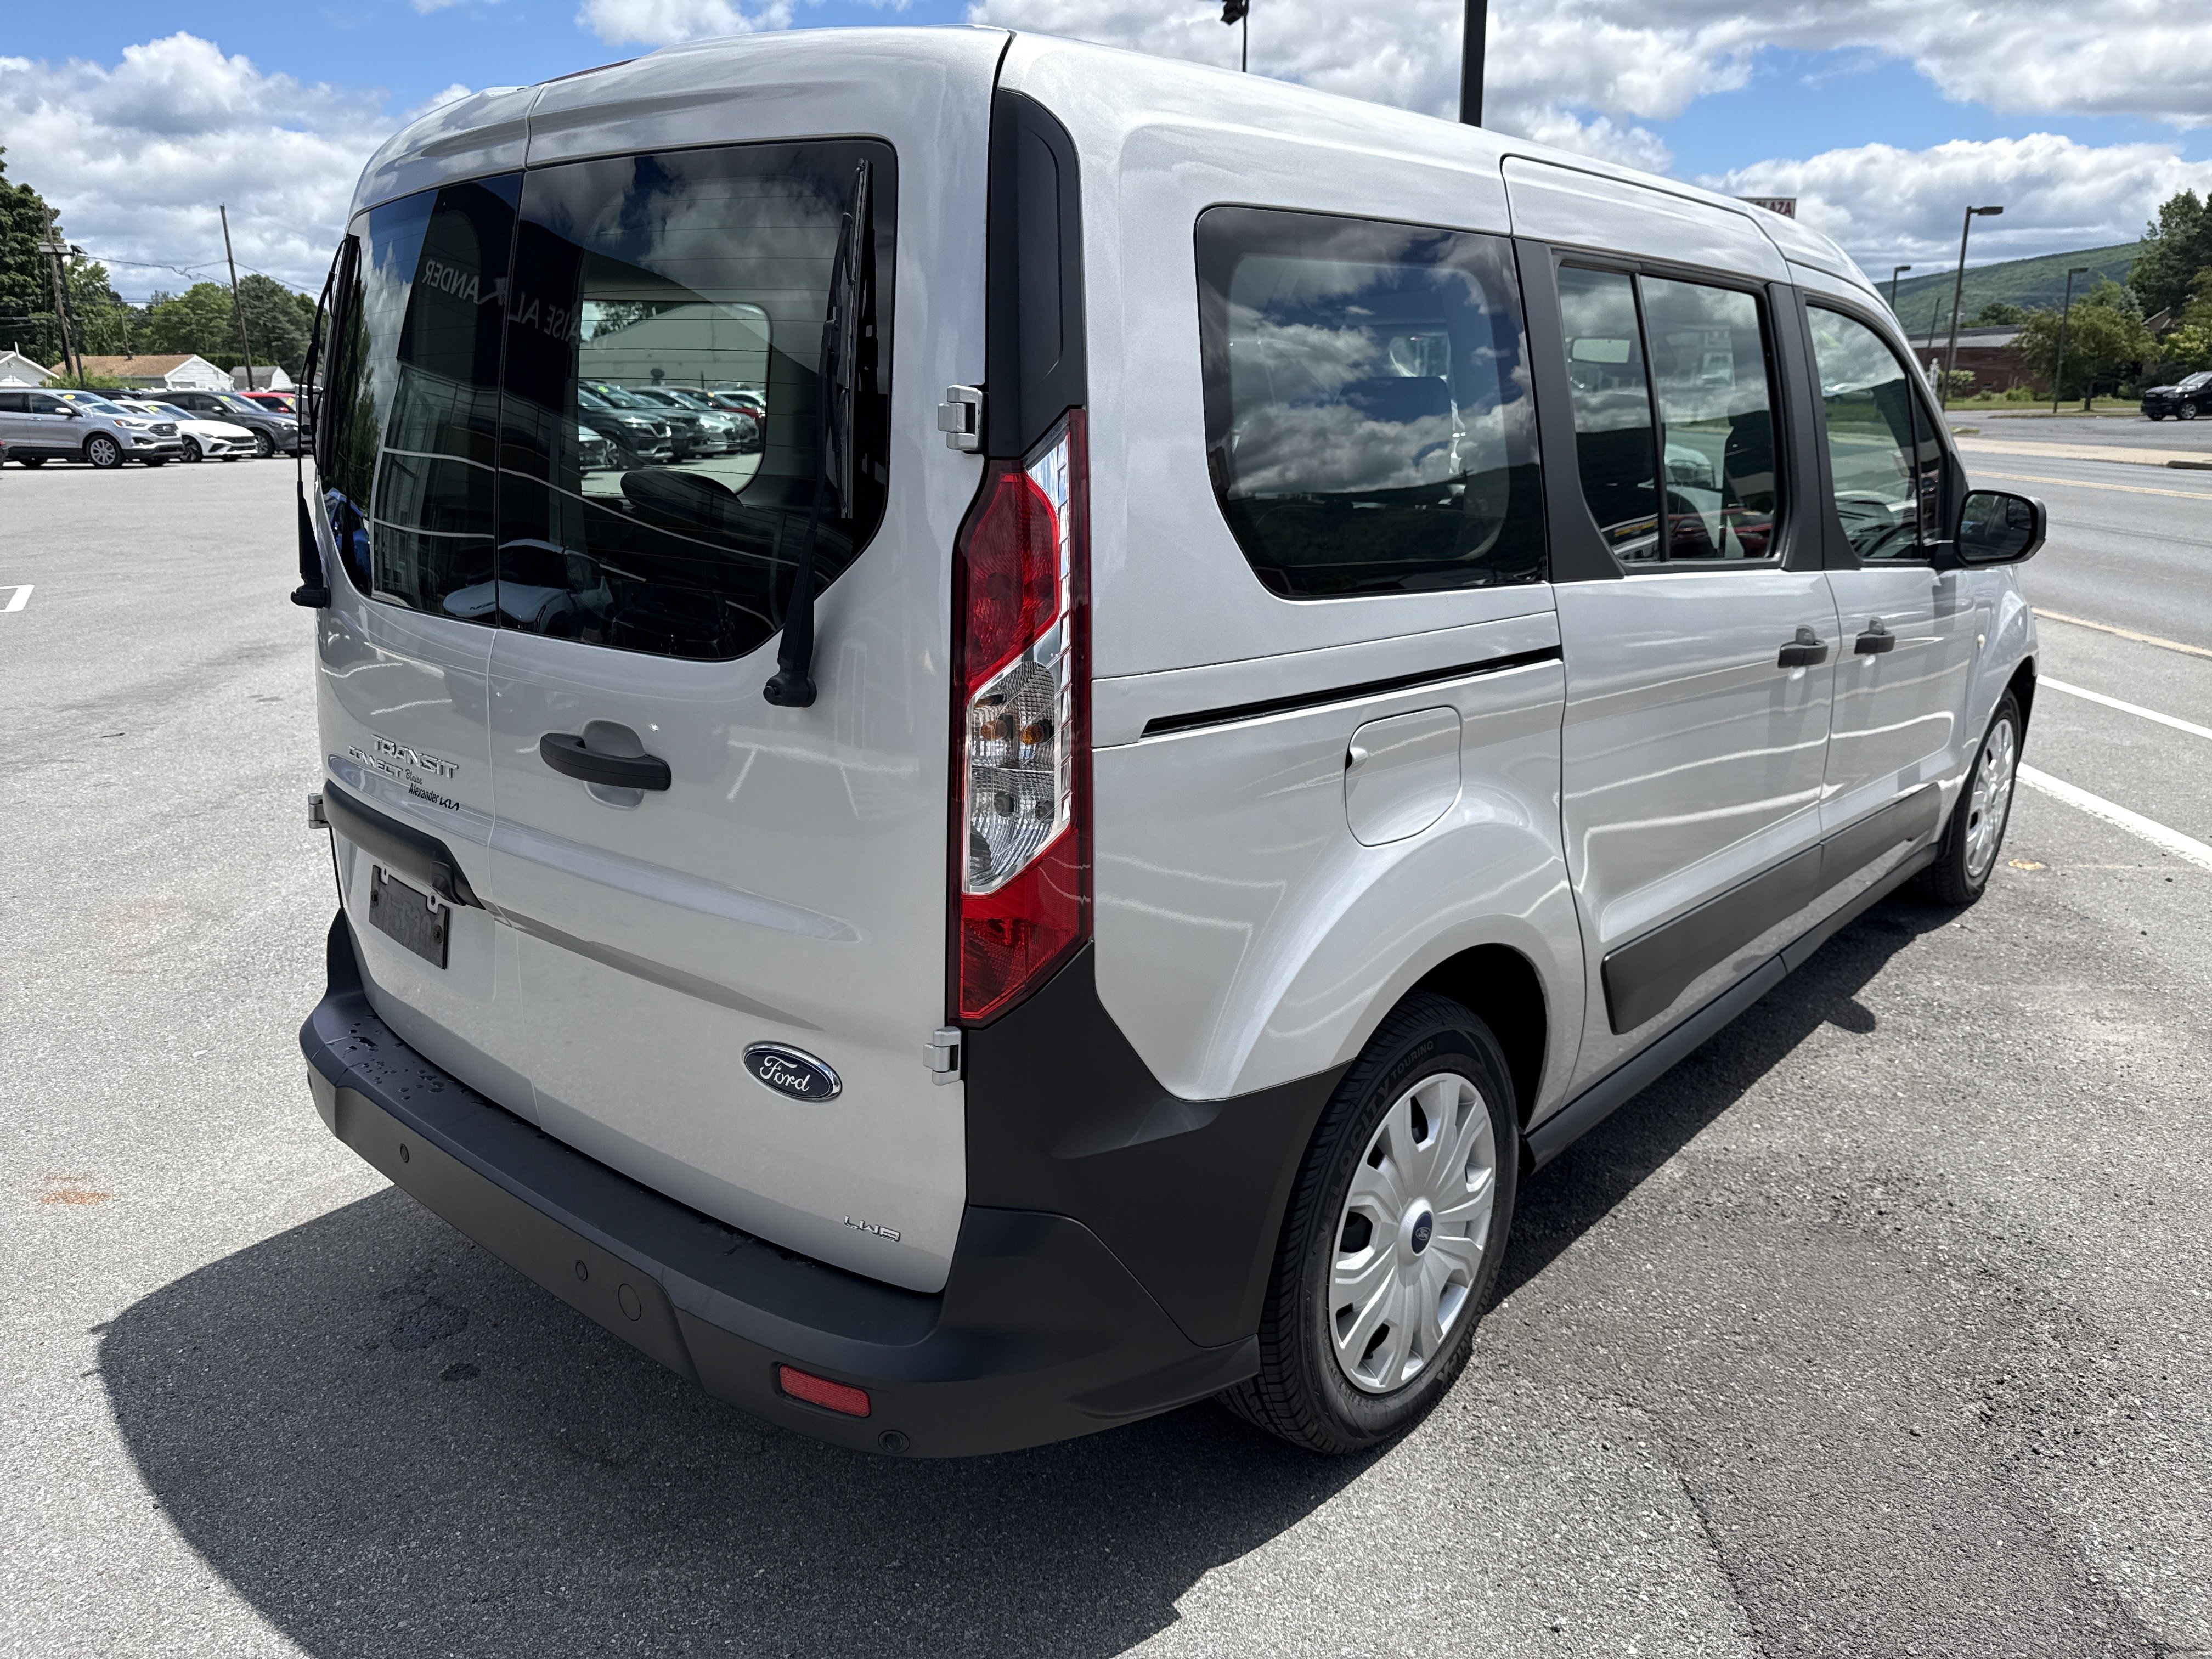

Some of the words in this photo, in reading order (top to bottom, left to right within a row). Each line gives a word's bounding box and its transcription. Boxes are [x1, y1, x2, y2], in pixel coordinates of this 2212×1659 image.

[1755, 201, 1791, 217] AZA
[348, 745, 403, 777] CONNECT
[370, 734, 459, 778] TRANSIT
[405, 768, 423, 785] Blaise
[408, 783, 439, 804] Alexander
[759, 1056, 811, 1092] Ford
[1390, 1040, 1434, 1080] TOURING
[843, 1215, 901, 1243] LWB
